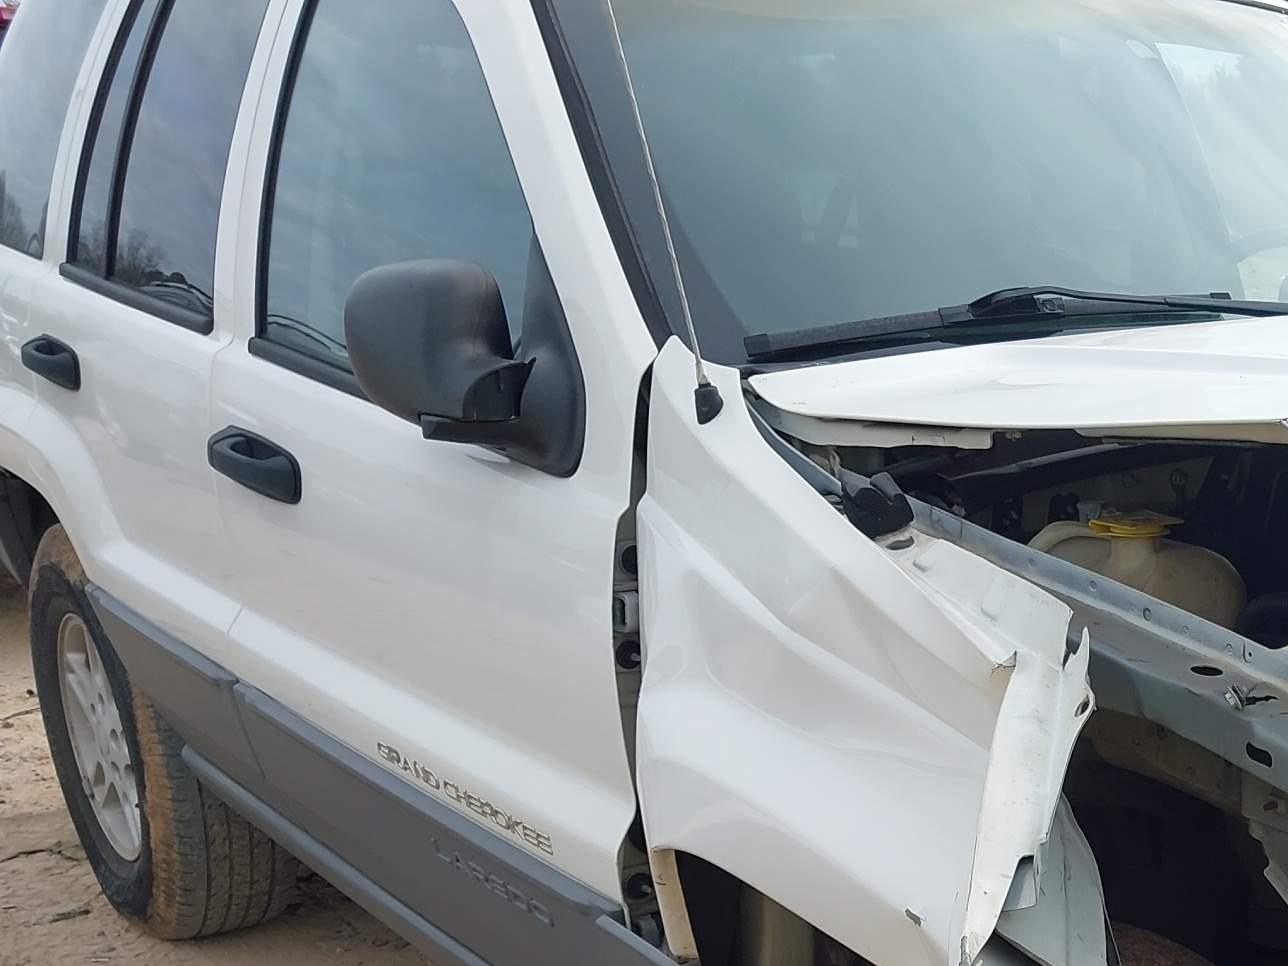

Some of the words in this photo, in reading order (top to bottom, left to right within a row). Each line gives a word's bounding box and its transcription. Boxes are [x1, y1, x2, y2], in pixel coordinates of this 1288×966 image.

[376, 741, 441, 791] GRAND
[443, 780, 554, 856] CHEROKEE
[431, 838, 555, 928] LAREDO
